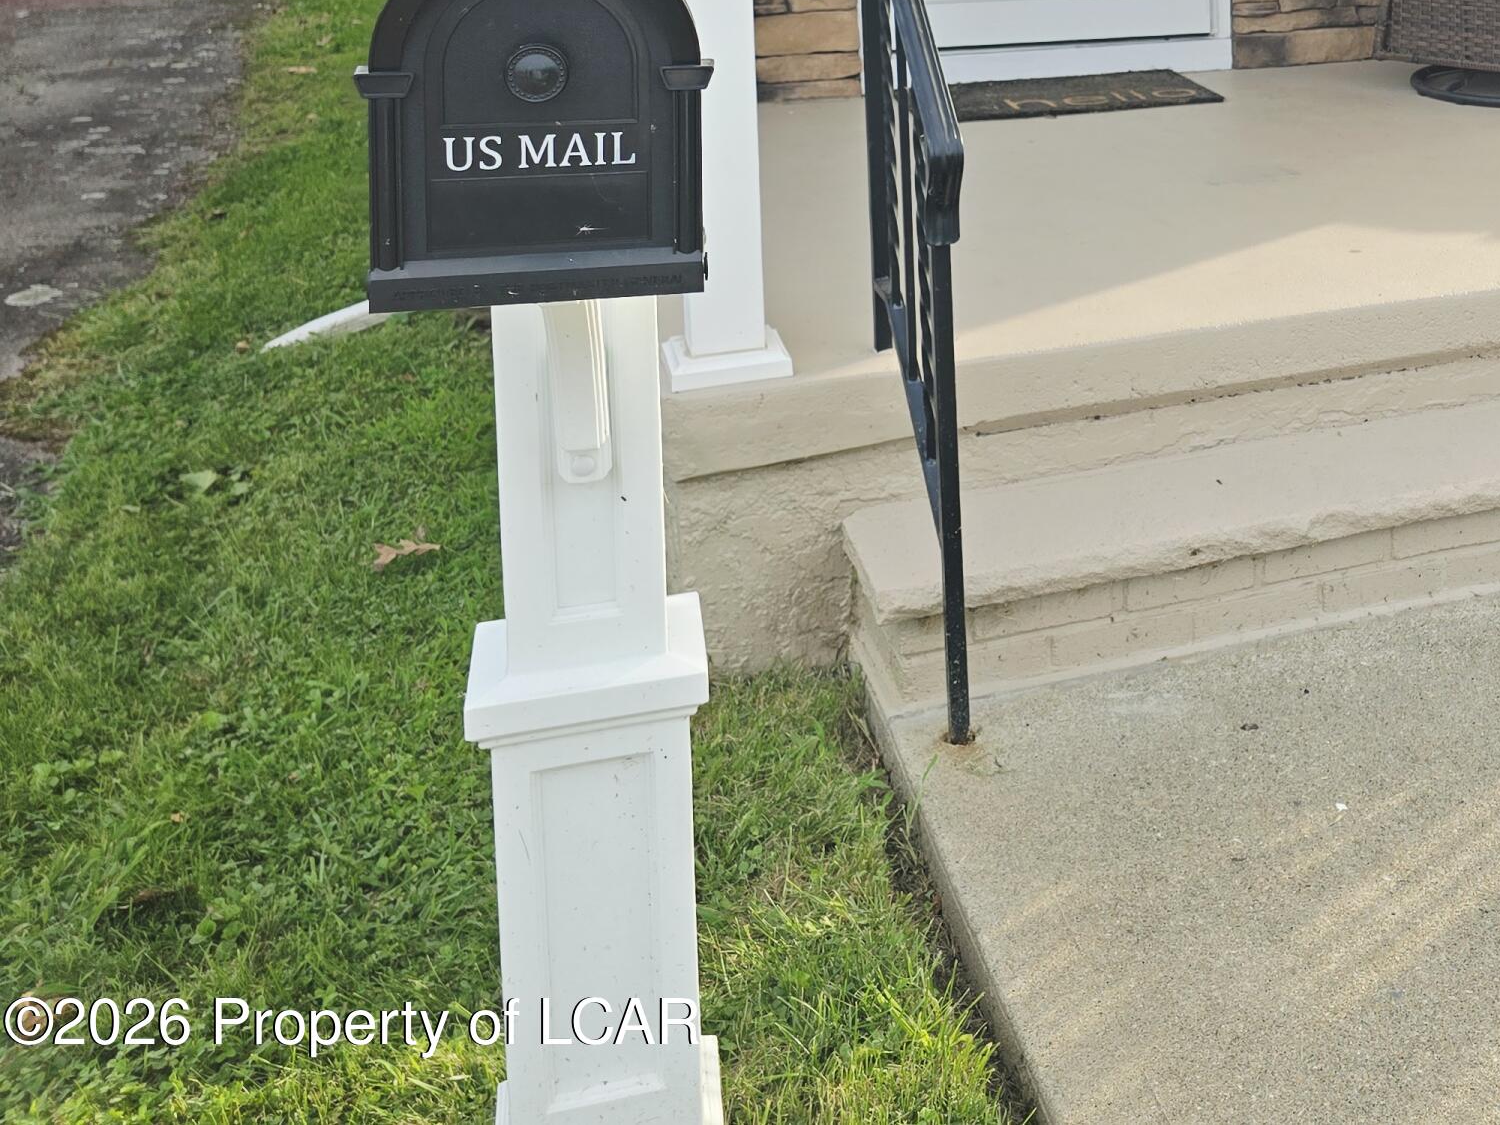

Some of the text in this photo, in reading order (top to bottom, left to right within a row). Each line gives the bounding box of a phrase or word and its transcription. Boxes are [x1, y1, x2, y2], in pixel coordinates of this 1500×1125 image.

[1003, 87, 1197, 110] hello
[443, 131, 637, 172] US MAIL
